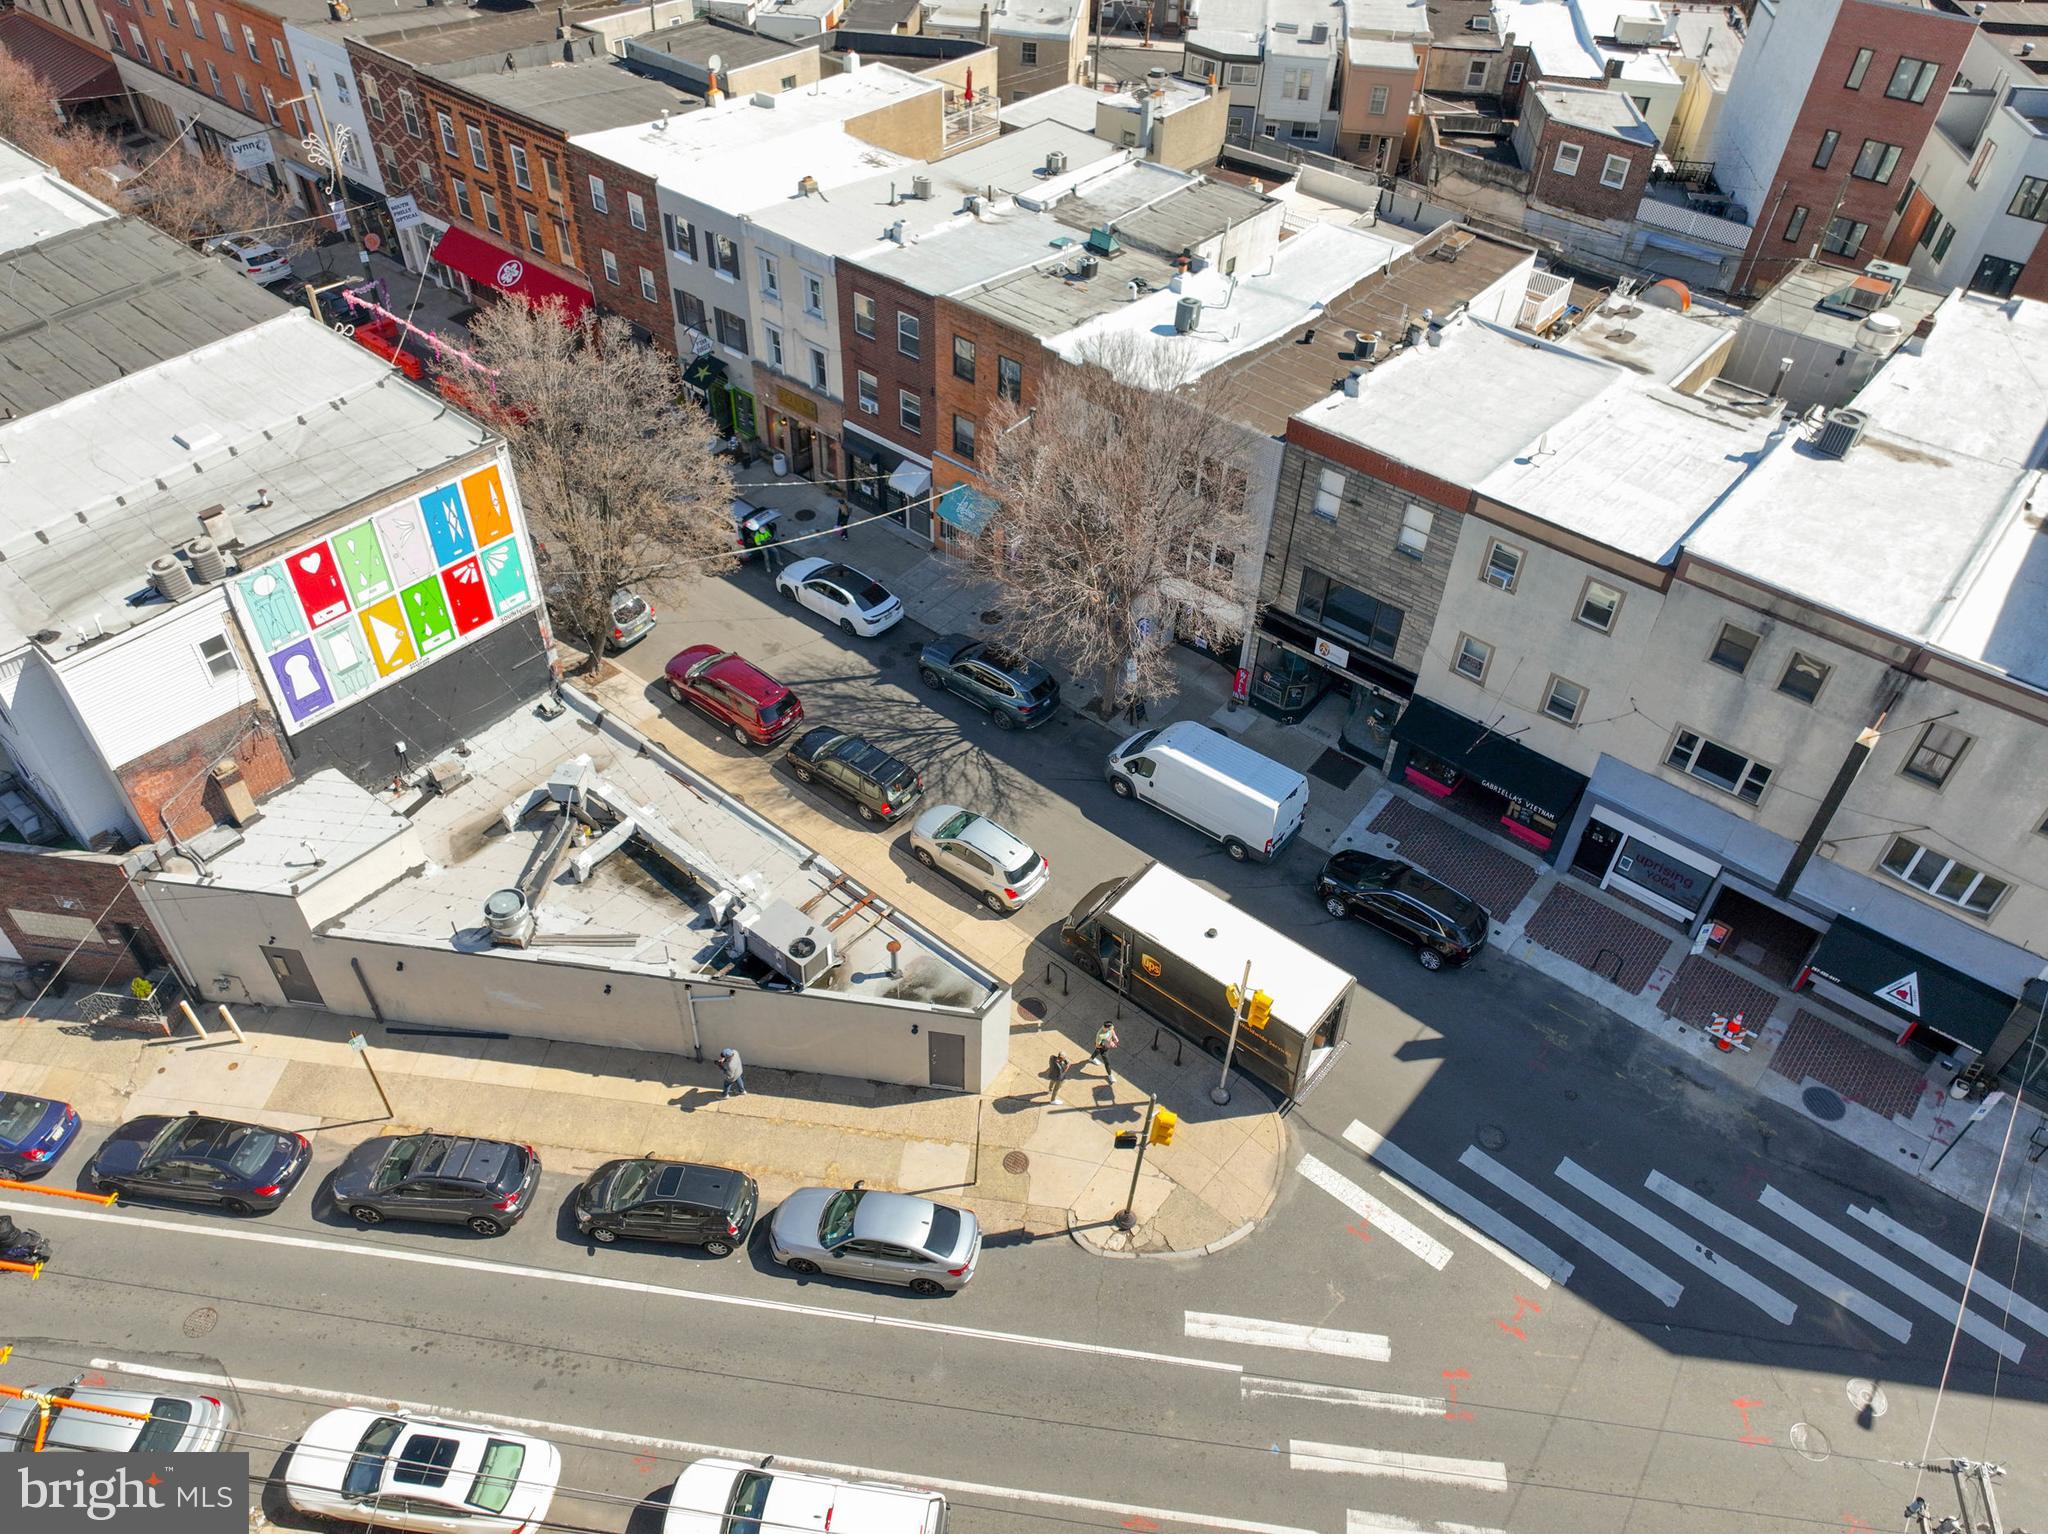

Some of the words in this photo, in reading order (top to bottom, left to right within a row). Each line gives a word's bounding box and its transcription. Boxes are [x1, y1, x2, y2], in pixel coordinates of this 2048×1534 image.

[391, 201, 409, 210] SOUTH
[394, 208, 412, 217] PHILLY
[395, 212, 419, 223] OPTICAL
[1481, 779, 1523, 805] GABRIELLA'S
[1525, 801, 1555, 820] VIETNAM
[1636, 853, 1694, 890] uprising
[1647, 870, 1677, 892] YOGA
[1144, 959, 1160, 974] ups
